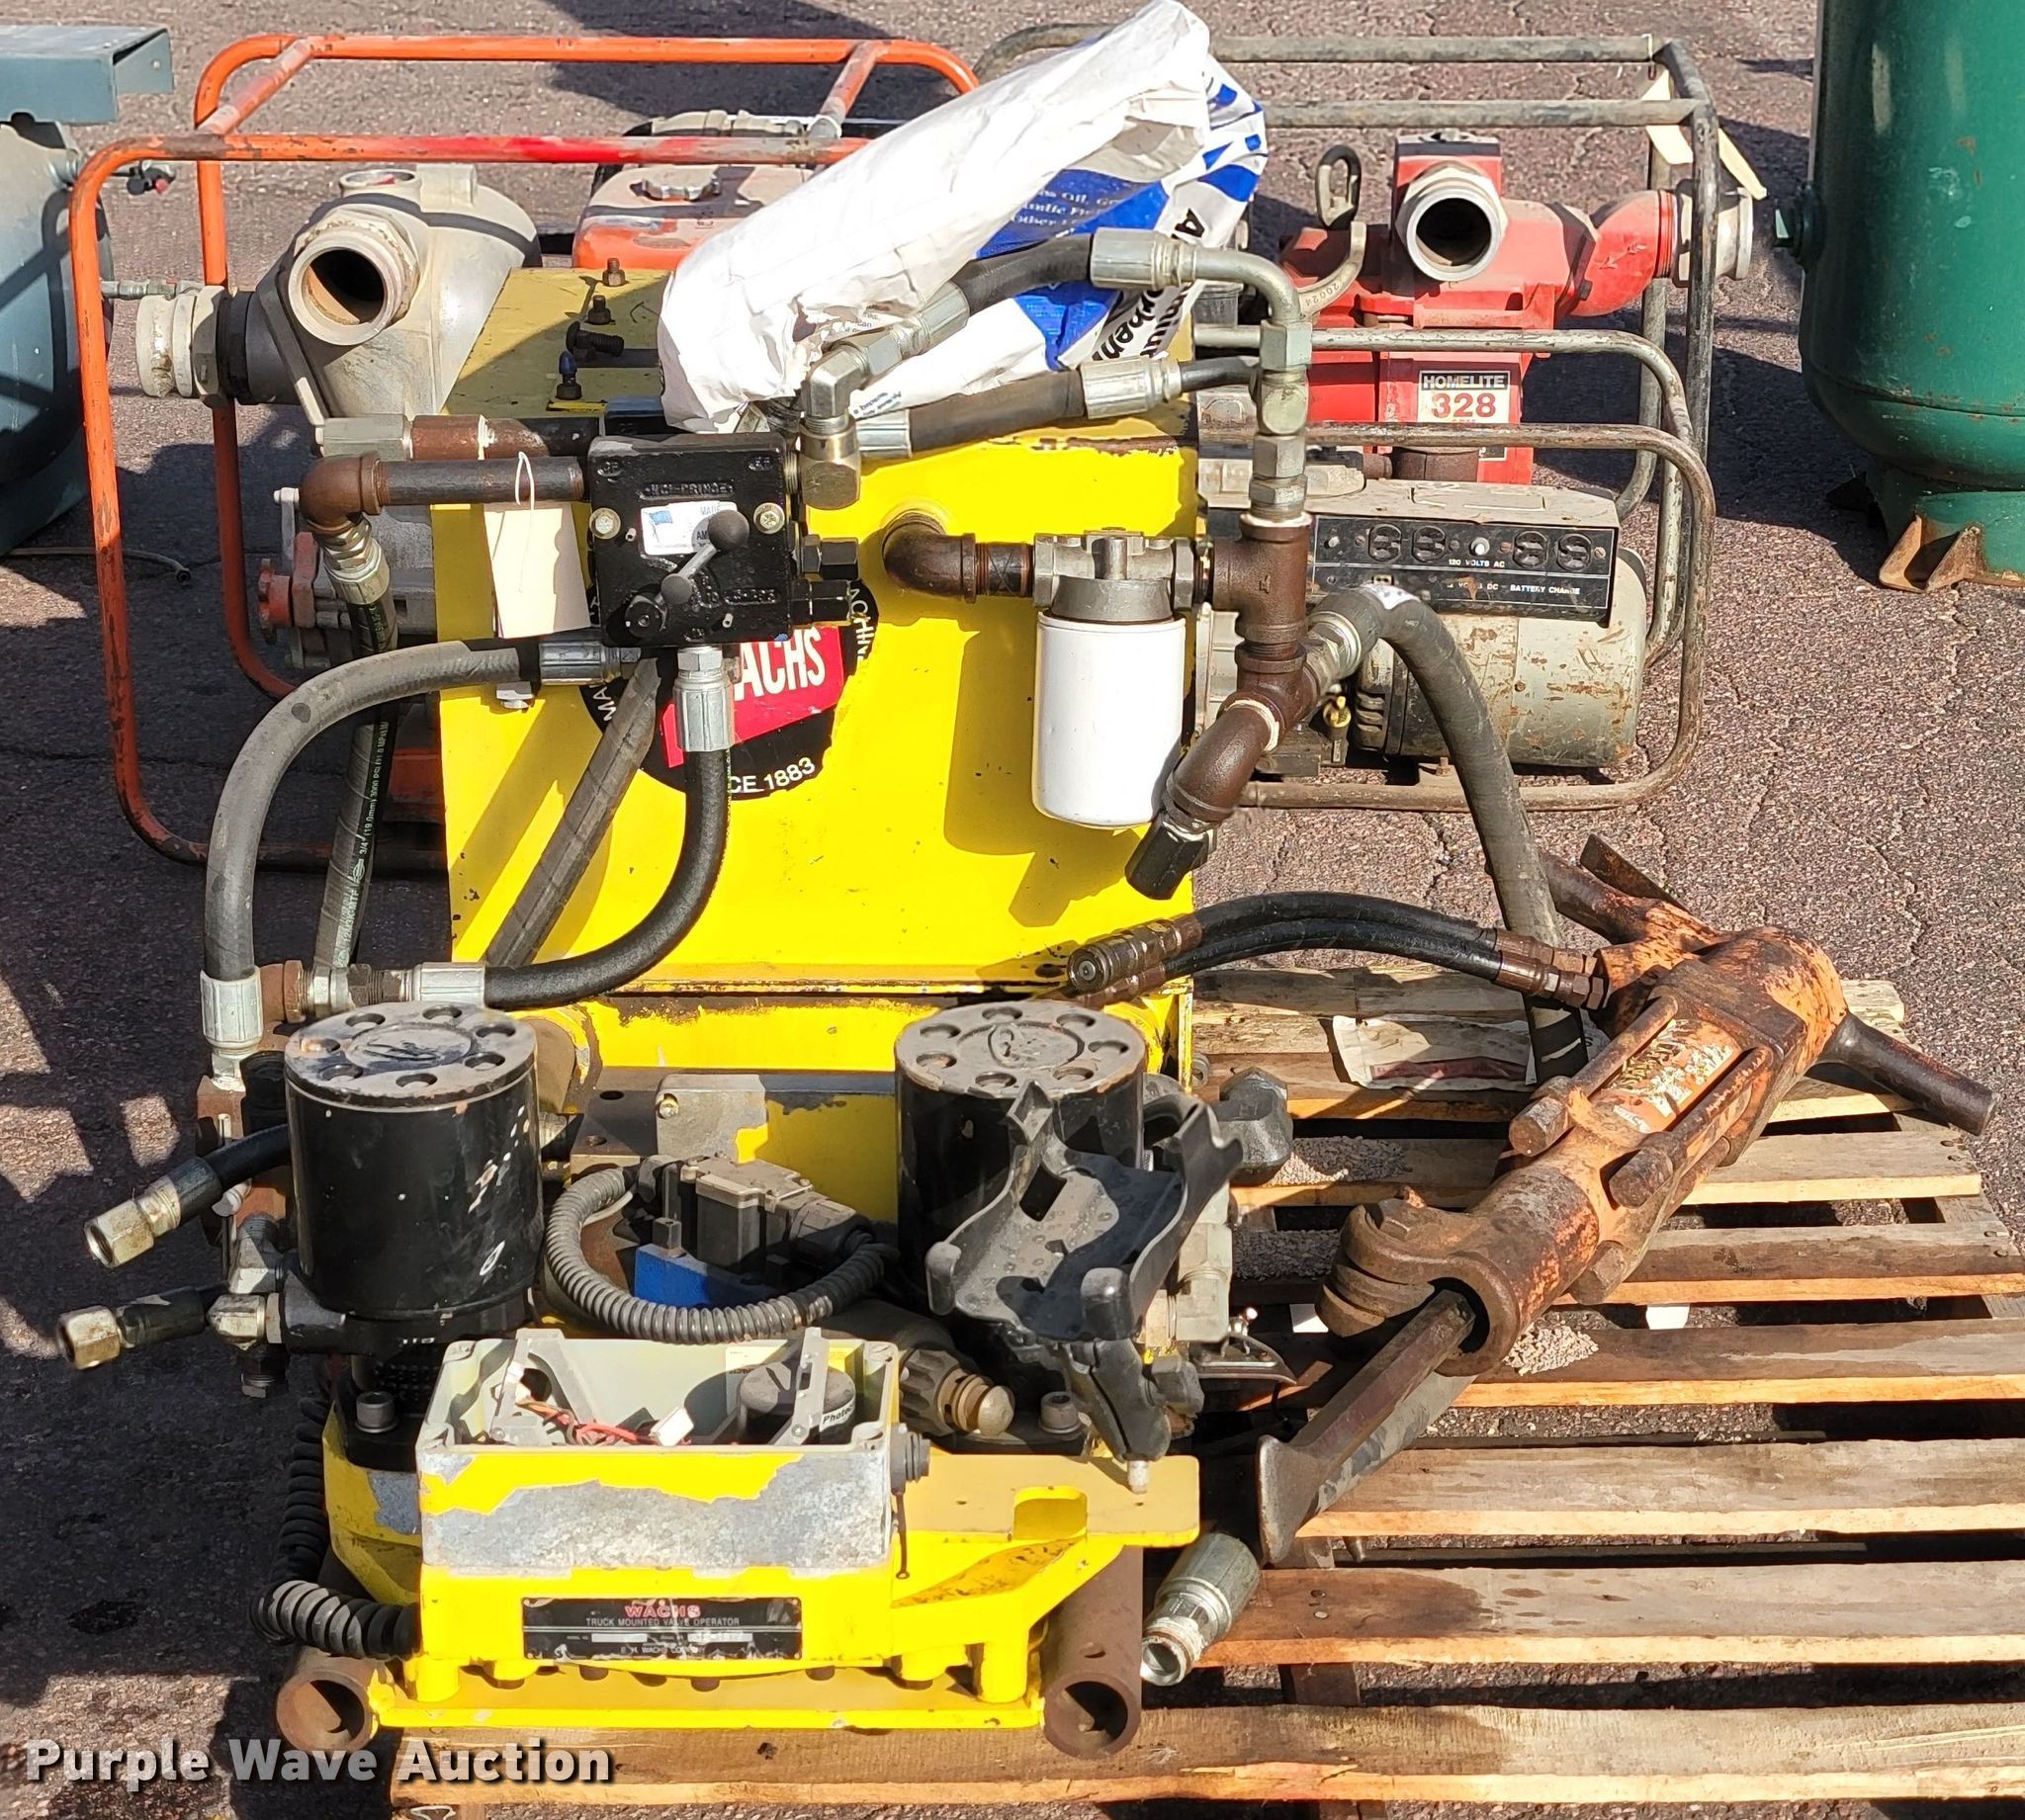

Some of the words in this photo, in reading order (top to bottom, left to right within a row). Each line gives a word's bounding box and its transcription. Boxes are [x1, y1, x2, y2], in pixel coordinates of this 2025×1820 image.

[1424, 375, 1504, 389] HOMELITE
[1432, 392, 1496, 418] 328
[763, 757, 816, 790] 1883
[586, 1617, 614, 1626] TRUCK
[618, 1617, 660, 1626] MOUNTED
[693, 1617, 740, 1626] OPERATOR
